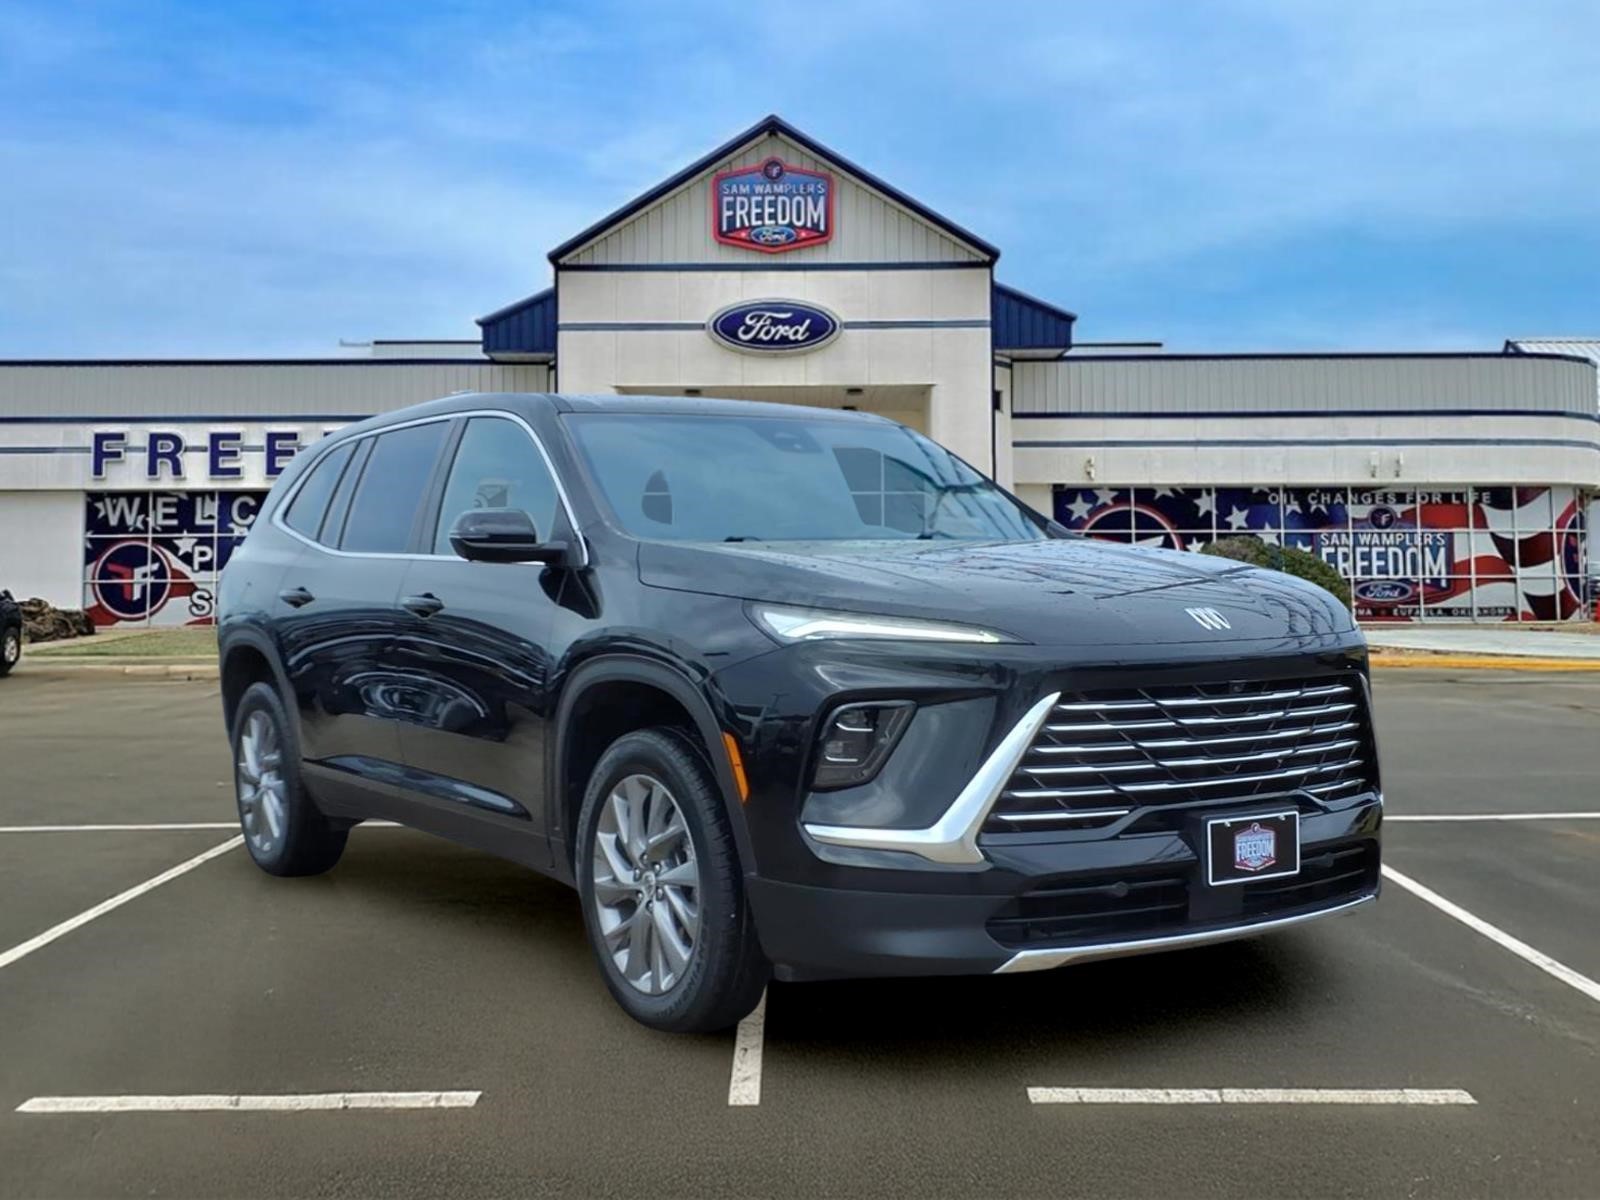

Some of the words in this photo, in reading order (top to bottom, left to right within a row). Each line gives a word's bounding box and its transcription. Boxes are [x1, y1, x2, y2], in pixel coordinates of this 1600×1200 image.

[722, 184, 750, 195] SAM
[722, 195, 826, 232] FREEDOM
[758, 228, 788, 243] Ford
[737, 310, 811, 342] Ford
[92, 431, 333, 478] FREE
[1268, 492, 1299, 505] OIL
[1308, 492, 1397, 505] CHANGES
[1406, 492, 1443, 504] FOR
[1451, 491, 1492, 504] LIFE
[1320, 546, 1448, 588] FREEDOM
[1365, 584, 1400, 598] Ford
